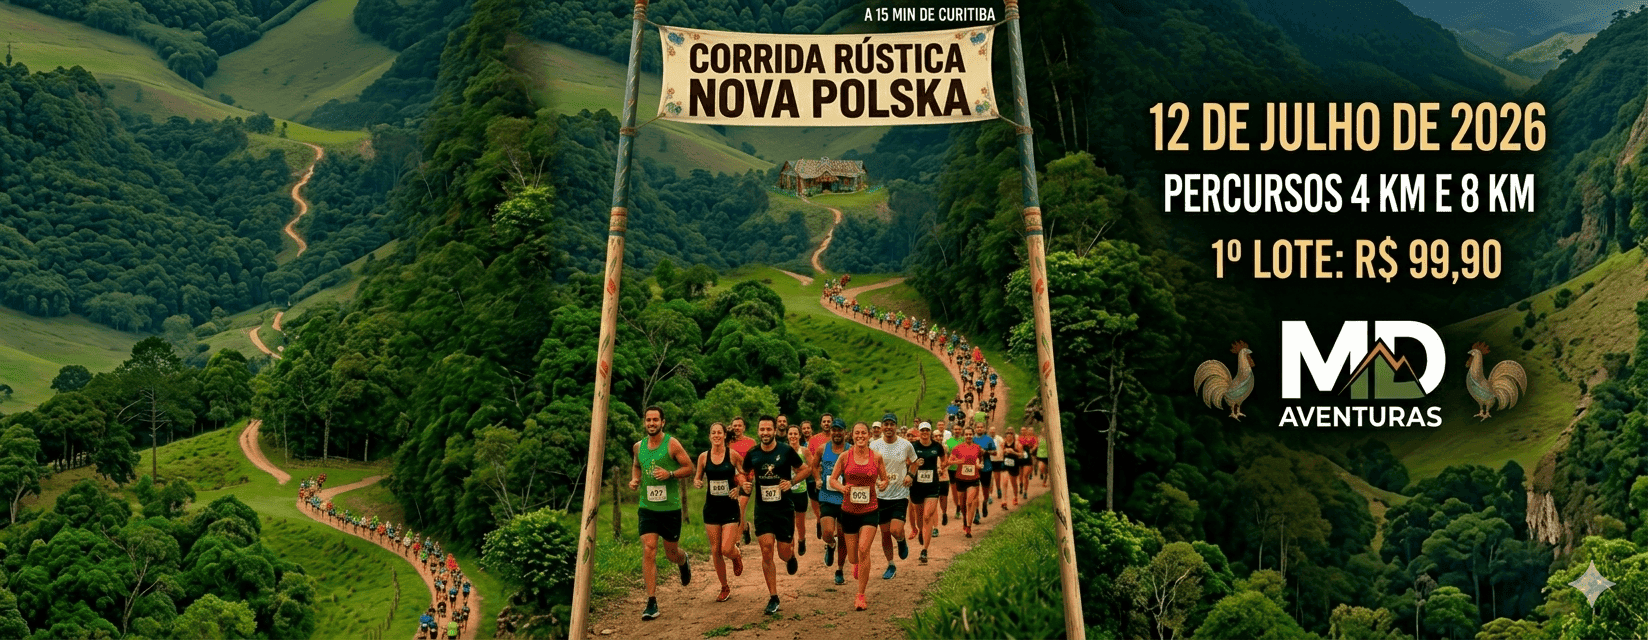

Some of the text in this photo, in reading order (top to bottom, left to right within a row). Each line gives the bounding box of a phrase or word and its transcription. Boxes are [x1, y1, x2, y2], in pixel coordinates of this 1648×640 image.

[689, 37, 966, 74] CORRIDA RÚSTICA
[689, 78, 972, 118] NOVA POLSKA
